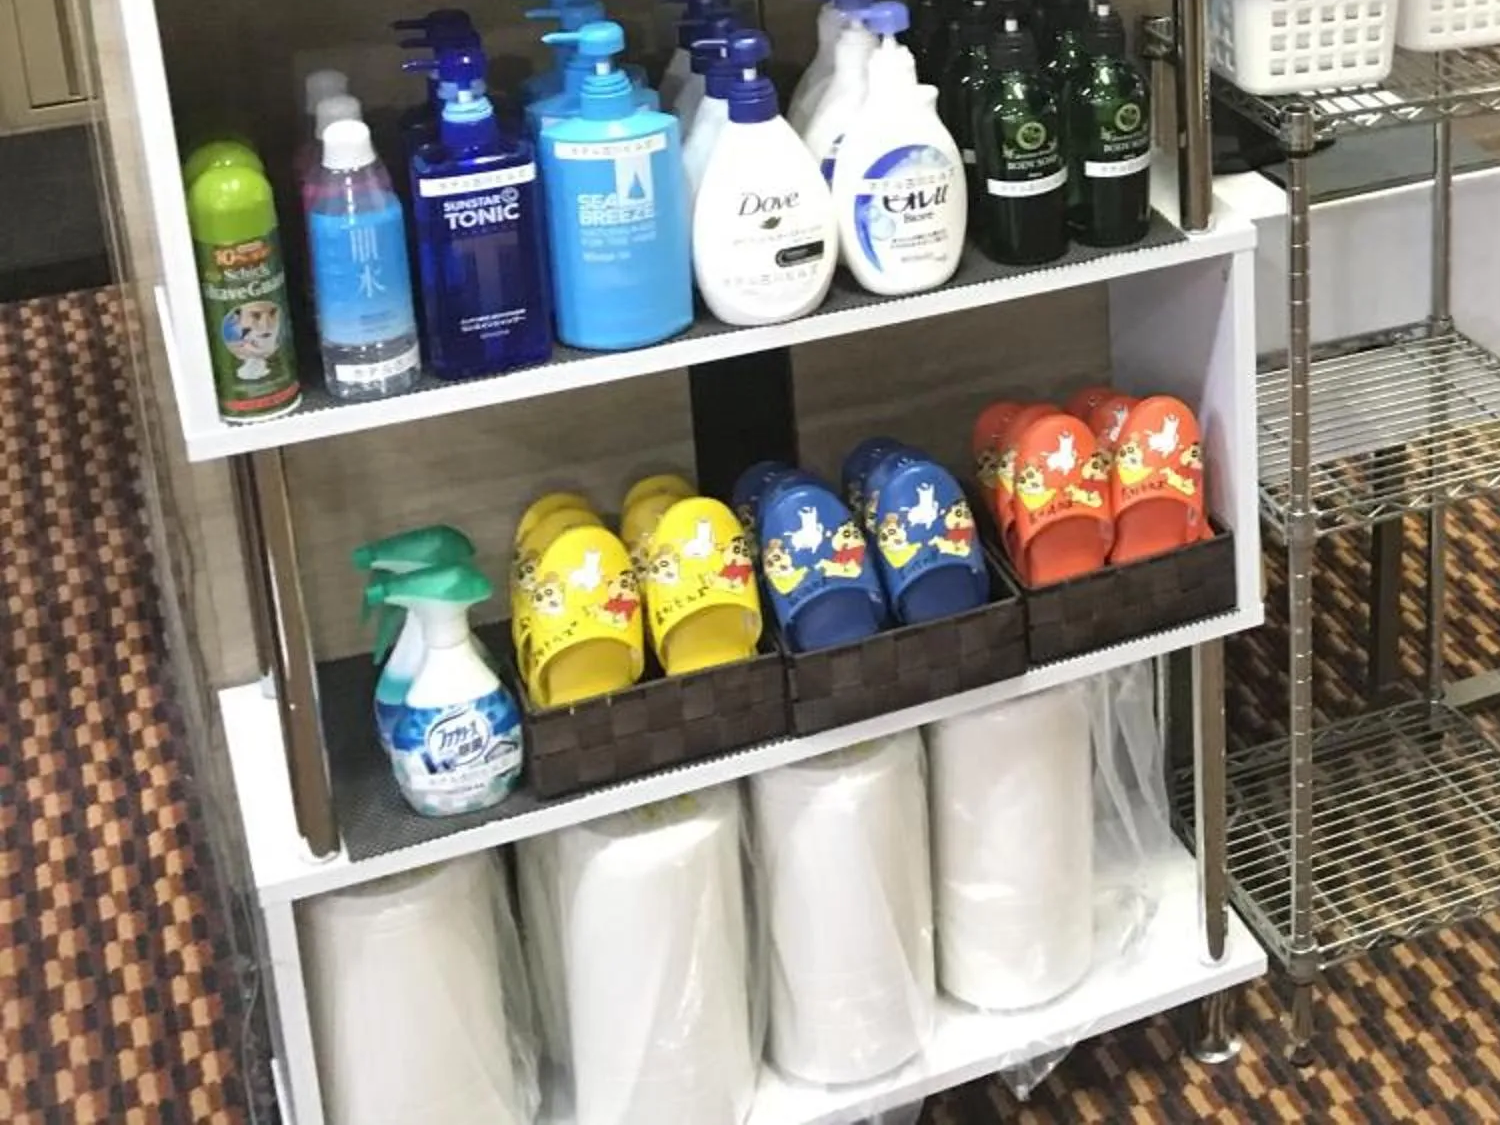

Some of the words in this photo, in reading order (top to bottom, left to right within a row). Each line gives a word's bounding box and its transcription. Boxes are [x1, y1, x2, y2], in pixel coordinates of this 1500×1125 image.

[444, 193, 501, 212] SUNSTAR
[577, 192, 619, 211] SEA
[738, 191, 800, 217] Dove
[443, 202, 521, 230] TONIC
[579, 202, 656, 225] BREEZE
